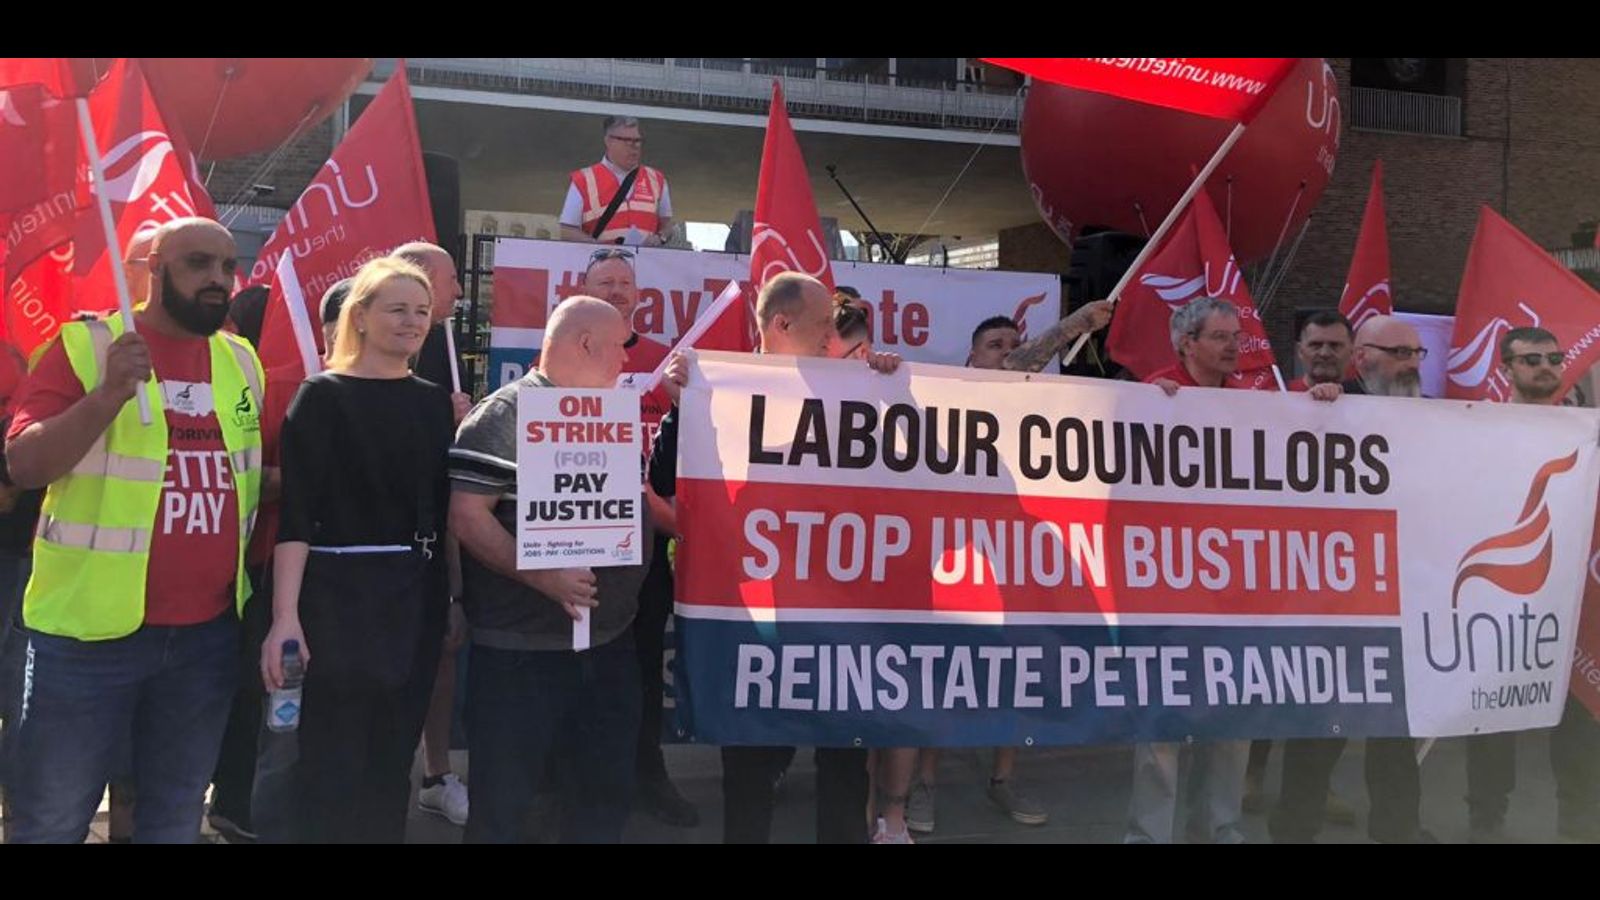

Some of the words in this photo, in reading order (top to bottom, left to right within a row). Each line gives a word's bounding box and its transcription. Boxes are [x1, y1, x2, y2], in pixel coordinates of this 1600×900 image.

[559, 395, 603, 417] ON
[526, 421, 634, 443] STRIKE
[748, 394, 1000, 477] LABOUR
[1018, 414, 1391, 495] COUNCILLORS
[554, 450, 608, 469] (FOR)
[554, 472, 608, 494] PAY
[163, 491, 226, 535] PAY
[525, 499, 634, 522] JUSTICE
[742, 508, 911, 583] STOP
[931, 516, 1108, 588] UNION
[1123, 525, 1356, 592] BUSTING
[734, 643, 1044, 712] REINSTATE
[1059, 645, 1191, 708] PETE
[1202, 645, 1393, 706] RANDLE
